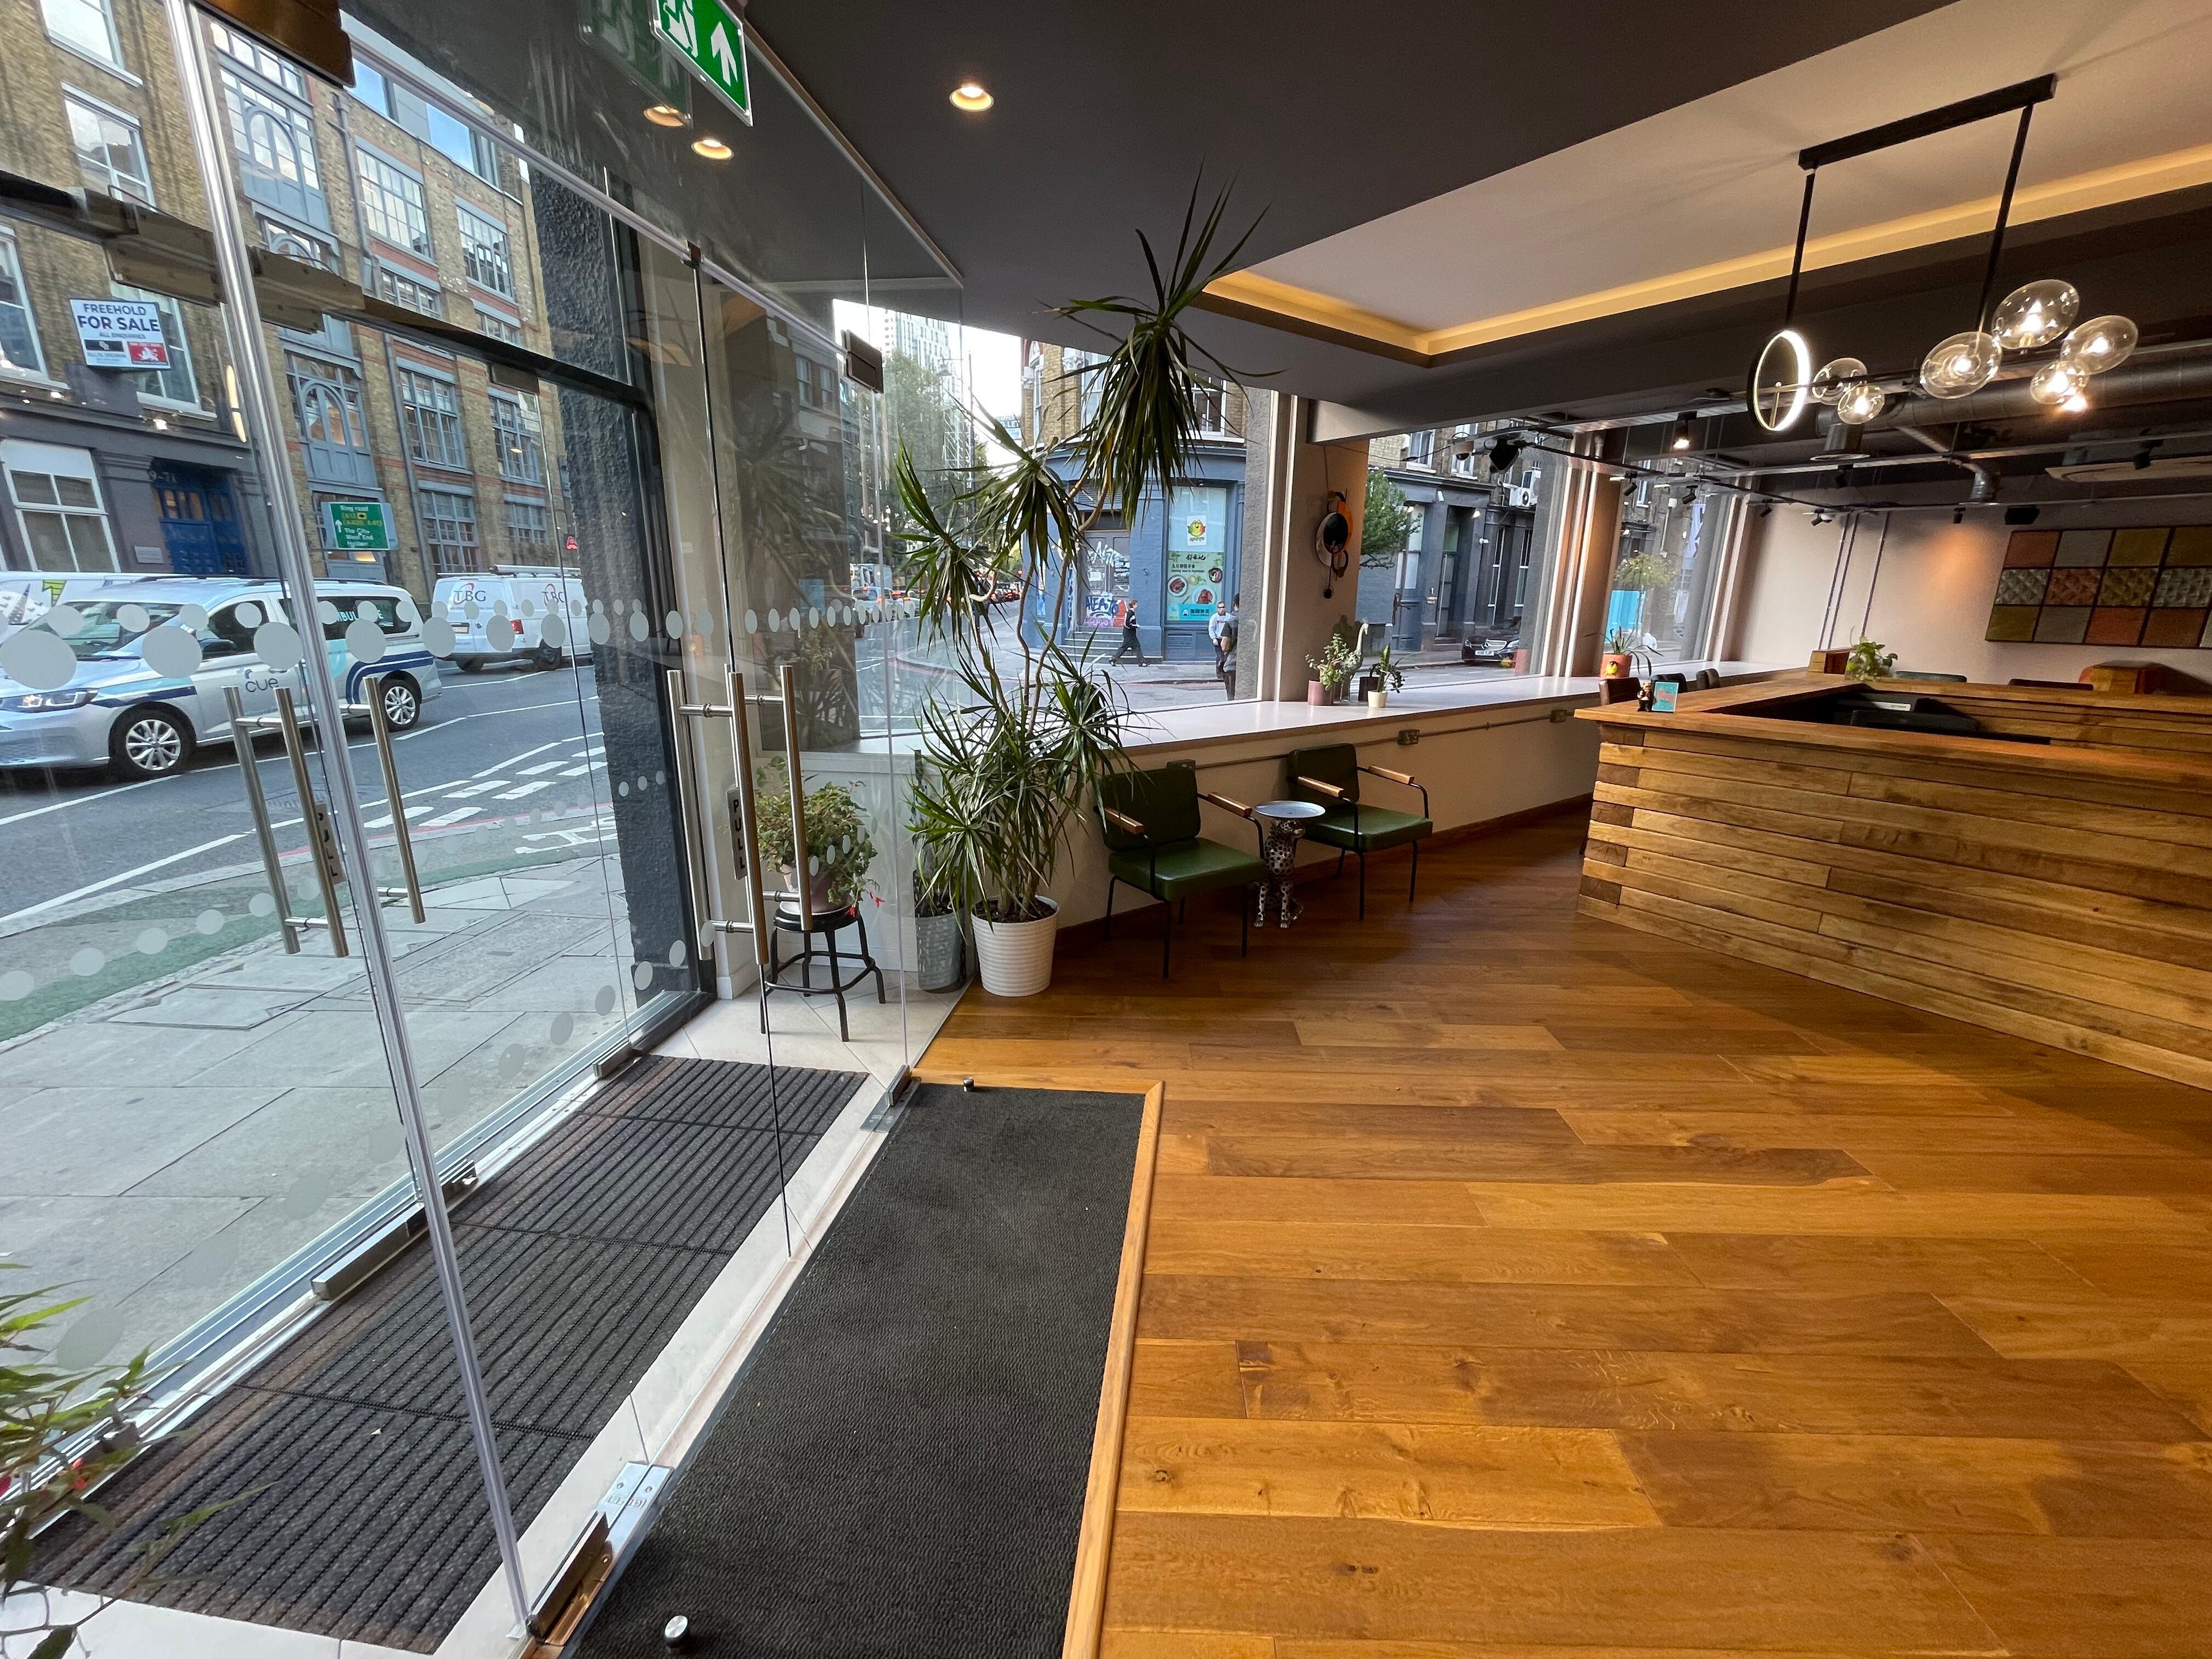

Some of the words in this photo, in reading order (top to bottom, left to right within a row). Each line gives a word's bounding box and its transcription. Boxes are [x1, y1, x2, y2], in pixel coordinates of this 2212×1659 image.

[83, 303, 146, 316] FREEHOLD
[77, 315, 113, 329] FOR
[116, 317, 160, 332] SALE
[453, 590, 486, 602] TBG
[245, 678, 279, 692] cue
[733, 799, 745, 870] PULL
